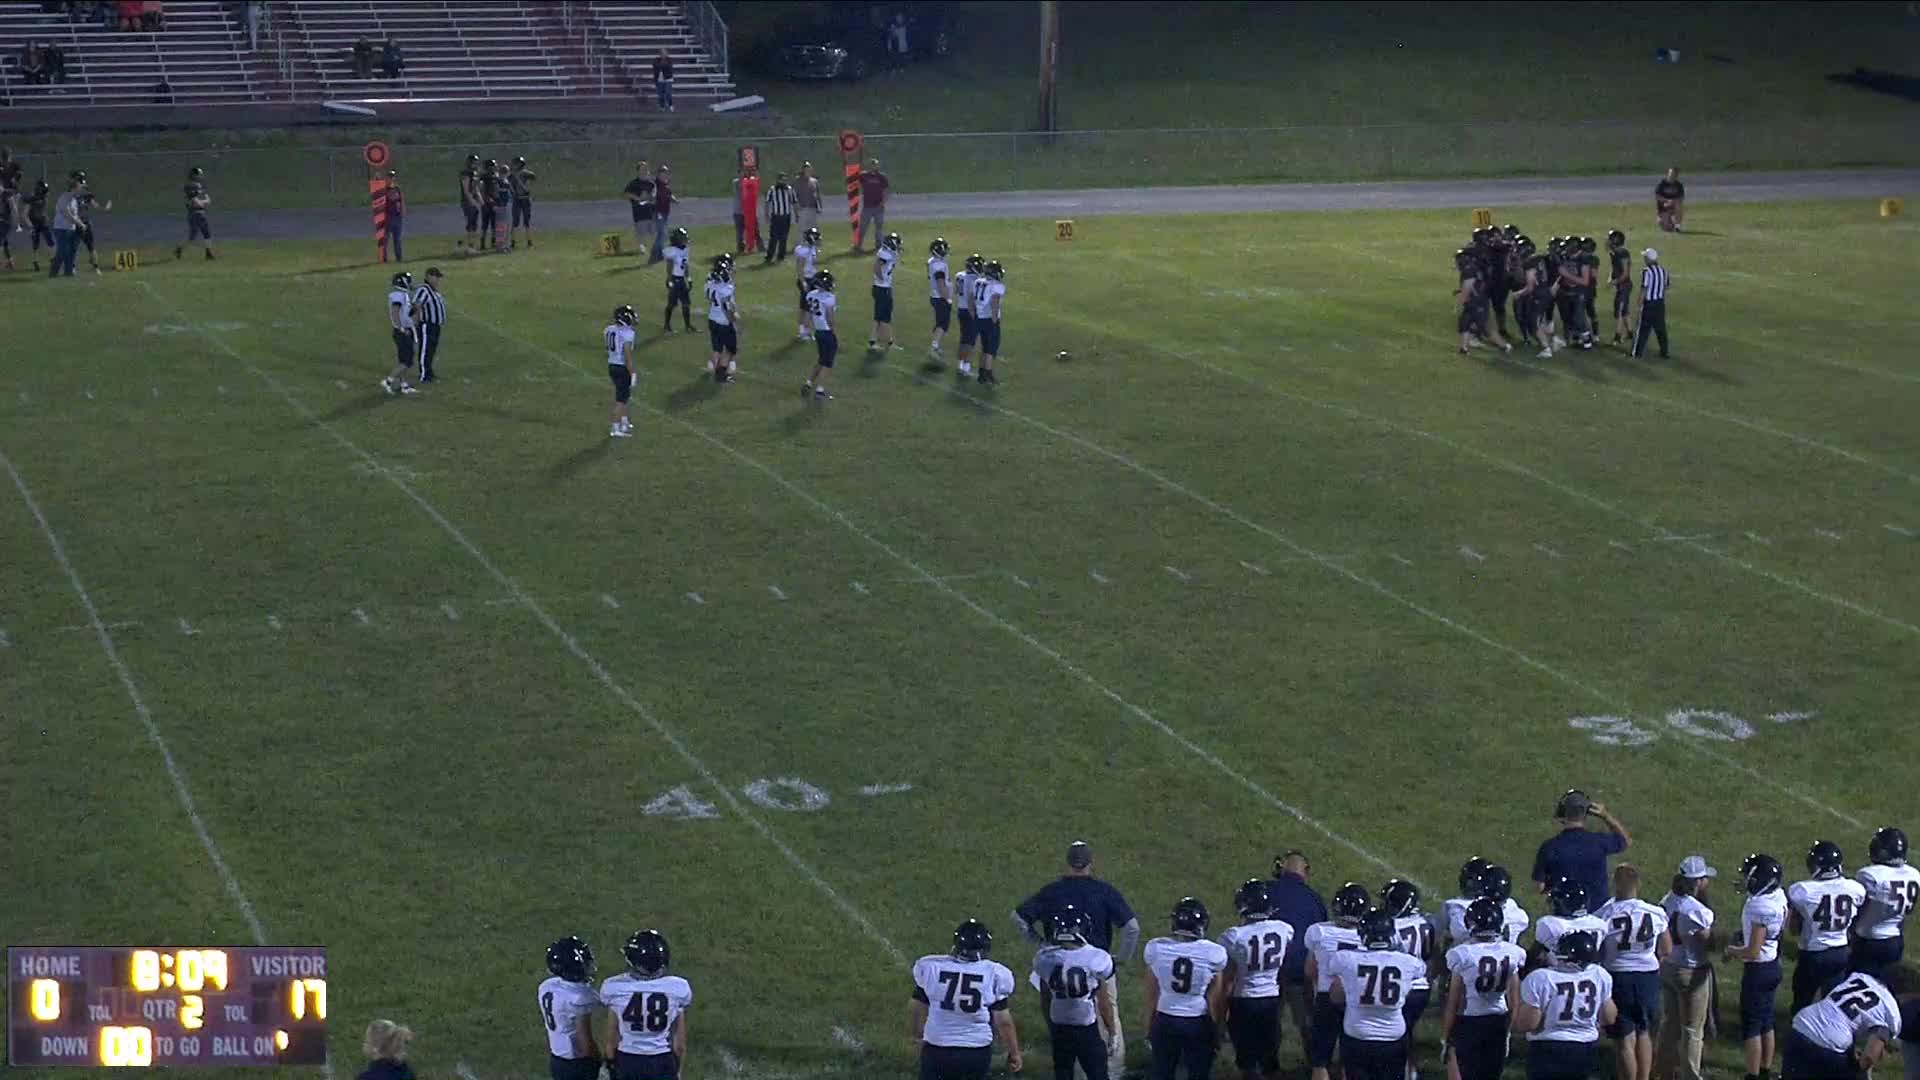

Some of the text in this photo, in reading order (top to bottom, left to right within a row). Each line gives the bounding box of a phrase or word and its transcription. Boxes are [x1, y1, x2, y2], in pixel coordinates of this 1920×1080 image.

[1058, 222, 1072, 237] 20
[118, 251, 134, 267] 40
[1812, 894, 1853, 932] 49
[1888, 880, 1920, 915] 59
[1612, 911, 1655, 950] 74
[1248, 931, 1282, 973] 12
[938, 970, 984, 1014] 75
[1050, 964, 1090, 1000] 40
[1171, 957, 1193, 994] 9
[1356, 965, 1401, 1006] 76
[1474, 956, 1511, 994] 81
[541, 991, 556, 1032] 8
[621, 991, 670, 1032] 48
[1557, 980, 1597, 1021] 73
[1829, 978, 1881, 1022] 72
